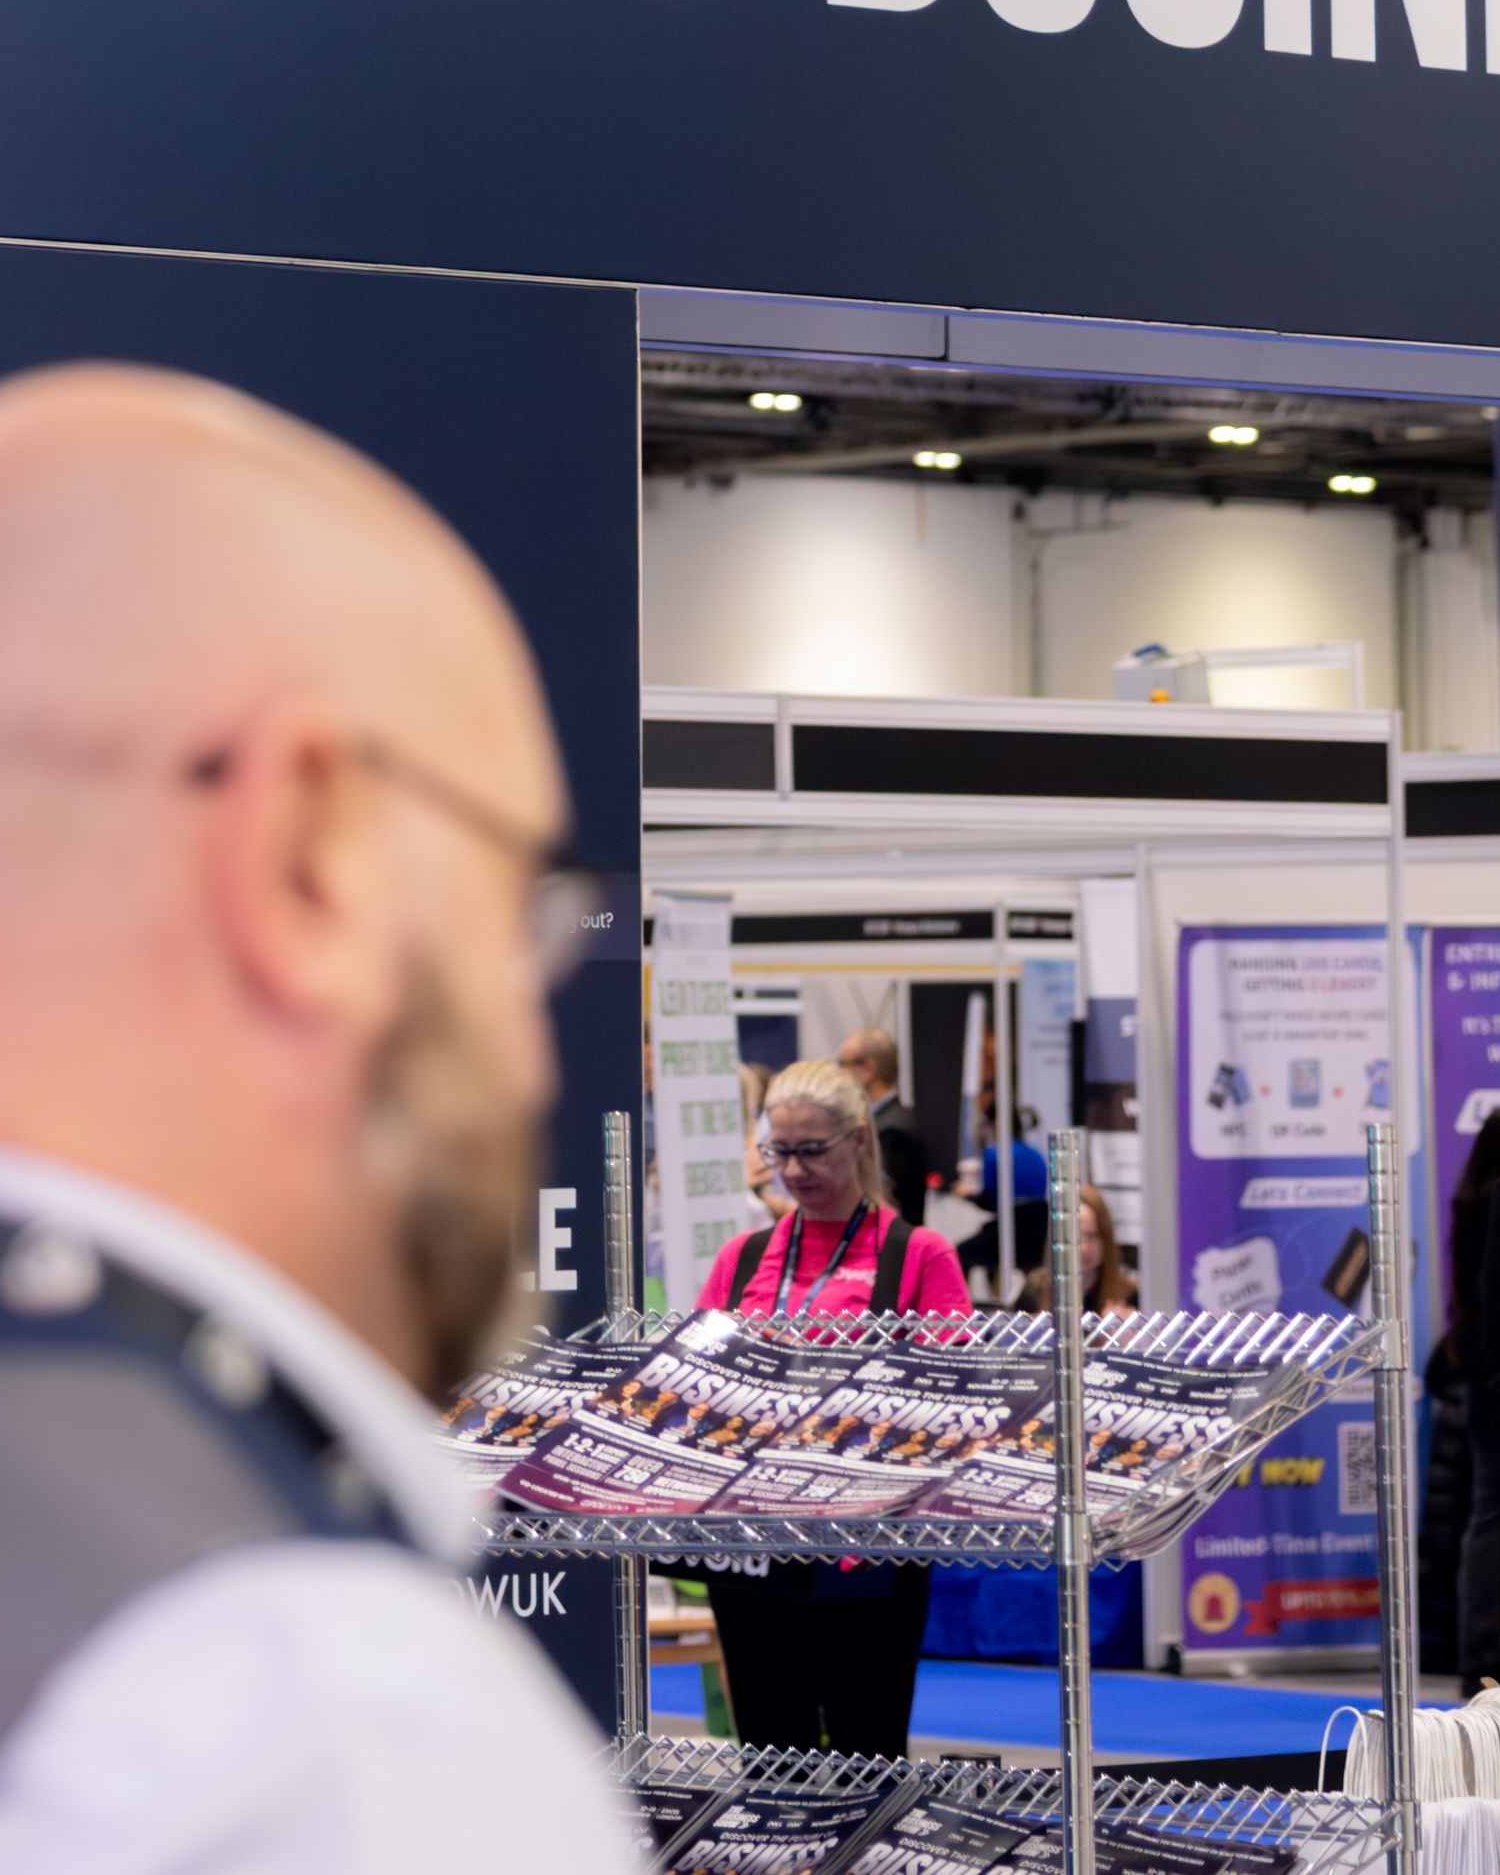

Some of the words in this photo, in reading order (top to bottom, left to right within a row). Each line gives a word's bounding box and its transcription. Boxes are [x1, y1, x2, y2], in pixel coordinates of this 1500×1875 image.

[580, 911, 615, 930] out?
[684, 1353, 743, 1381] DISCOVER
[741, 1374, 761, 1387] THE
[761, 1379, 803, 1394] FUTURE
[803, 1384, 822, 1396] OF
[862, 1382, 922, 1399] DISCOVER
[922, 1390, 946, 1401] THE
[945, 1393, 987, 1406] FUTURE
[987, 1396, 1006, 1407] OF
[1084, 1388, 1143, 1405] DISCOVER
[1143, 1397, 1167, 1408] THE
[1166, 1402, 1208, 1415] FUTURE
[1208, 1406, 1228, 1416] OF
[819, 1388, 1012, 1440] BUSINESS
[563, 1432, 608, 1459] 1-2-1
[612, 1463, 652, 1485] 750
[627, 1454, 666, 1475] OVER
[1260, 1456, 1325, 1488] NOW
[720, 1832, 770, 1842] DISCOVER
[770, 1834, 788, 1843] THE
[899, 1837, 951, 1857] DISCOVER
[950, 1851, 970, 1863] THE
